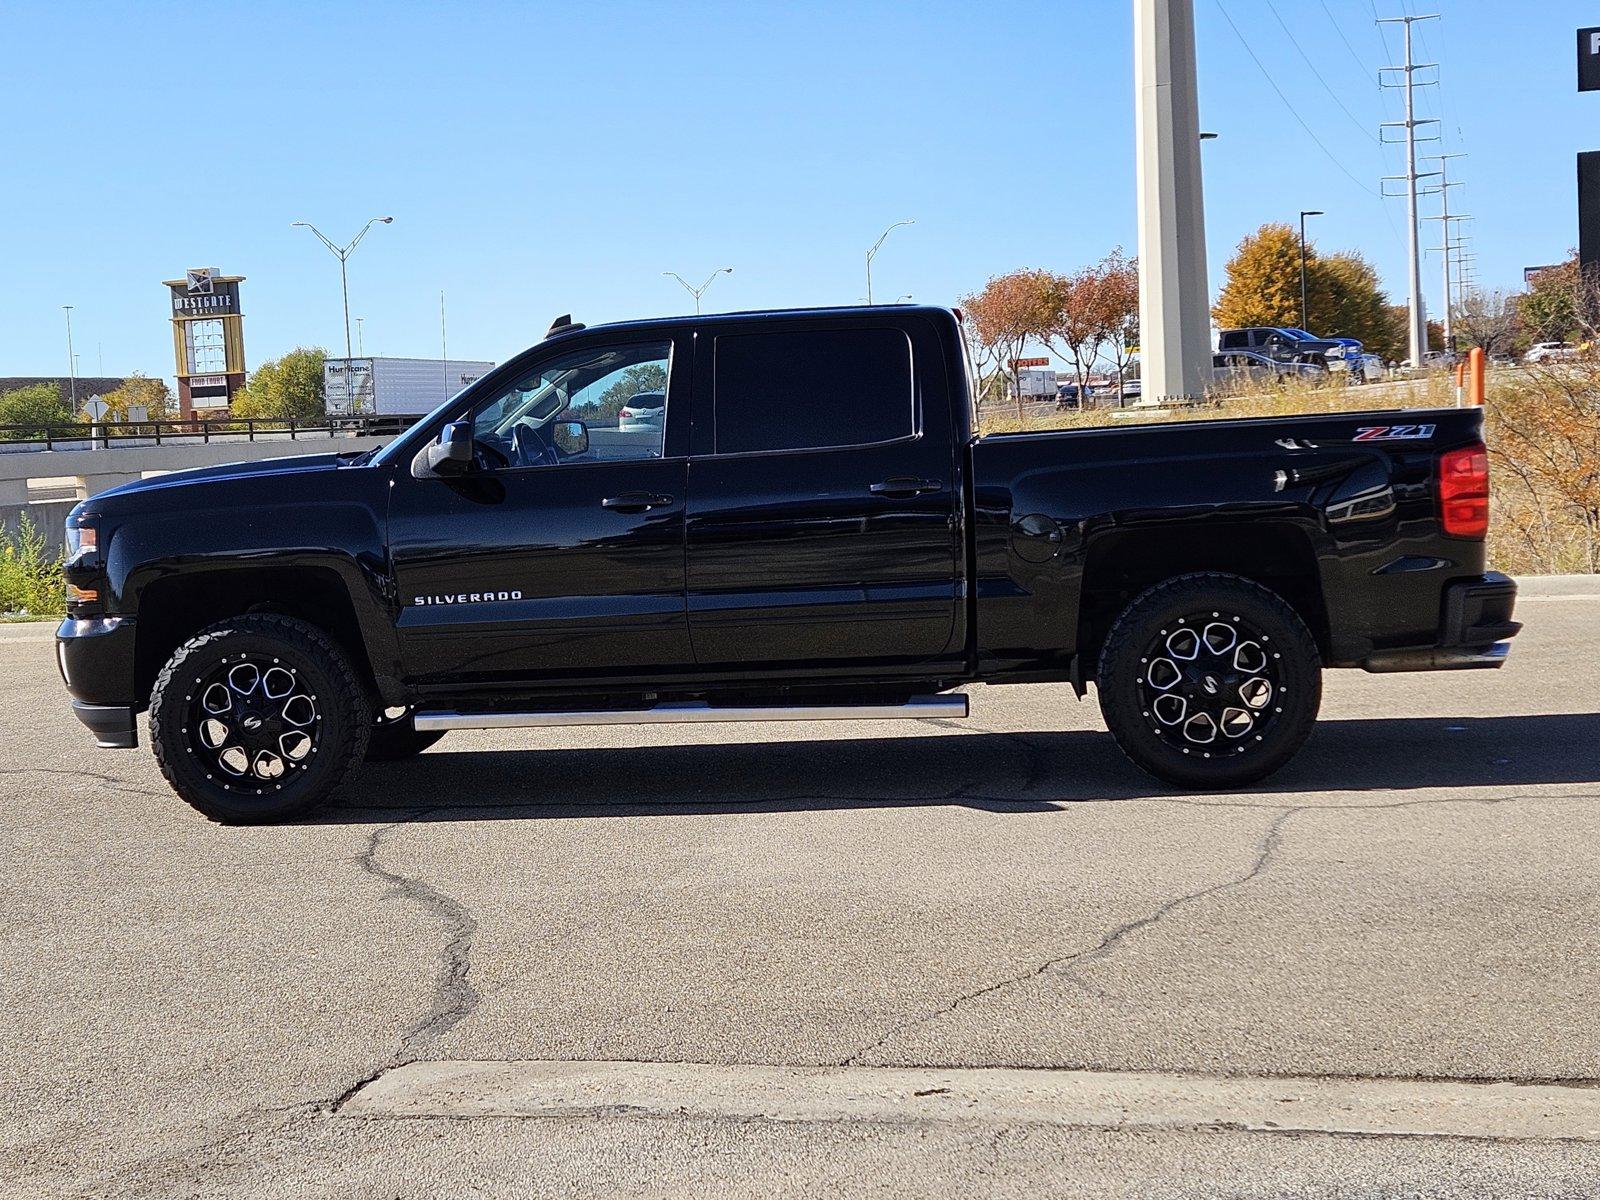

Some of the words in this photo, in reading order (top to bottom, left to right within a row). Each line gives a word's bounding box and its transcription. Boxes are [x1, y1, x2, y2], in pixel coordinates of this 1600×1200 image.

[174, 295, 231, 310] WESTGATE
[1352, 424, 1437, 441] Z71
[414, 590, 522, 606] SILVERADO
